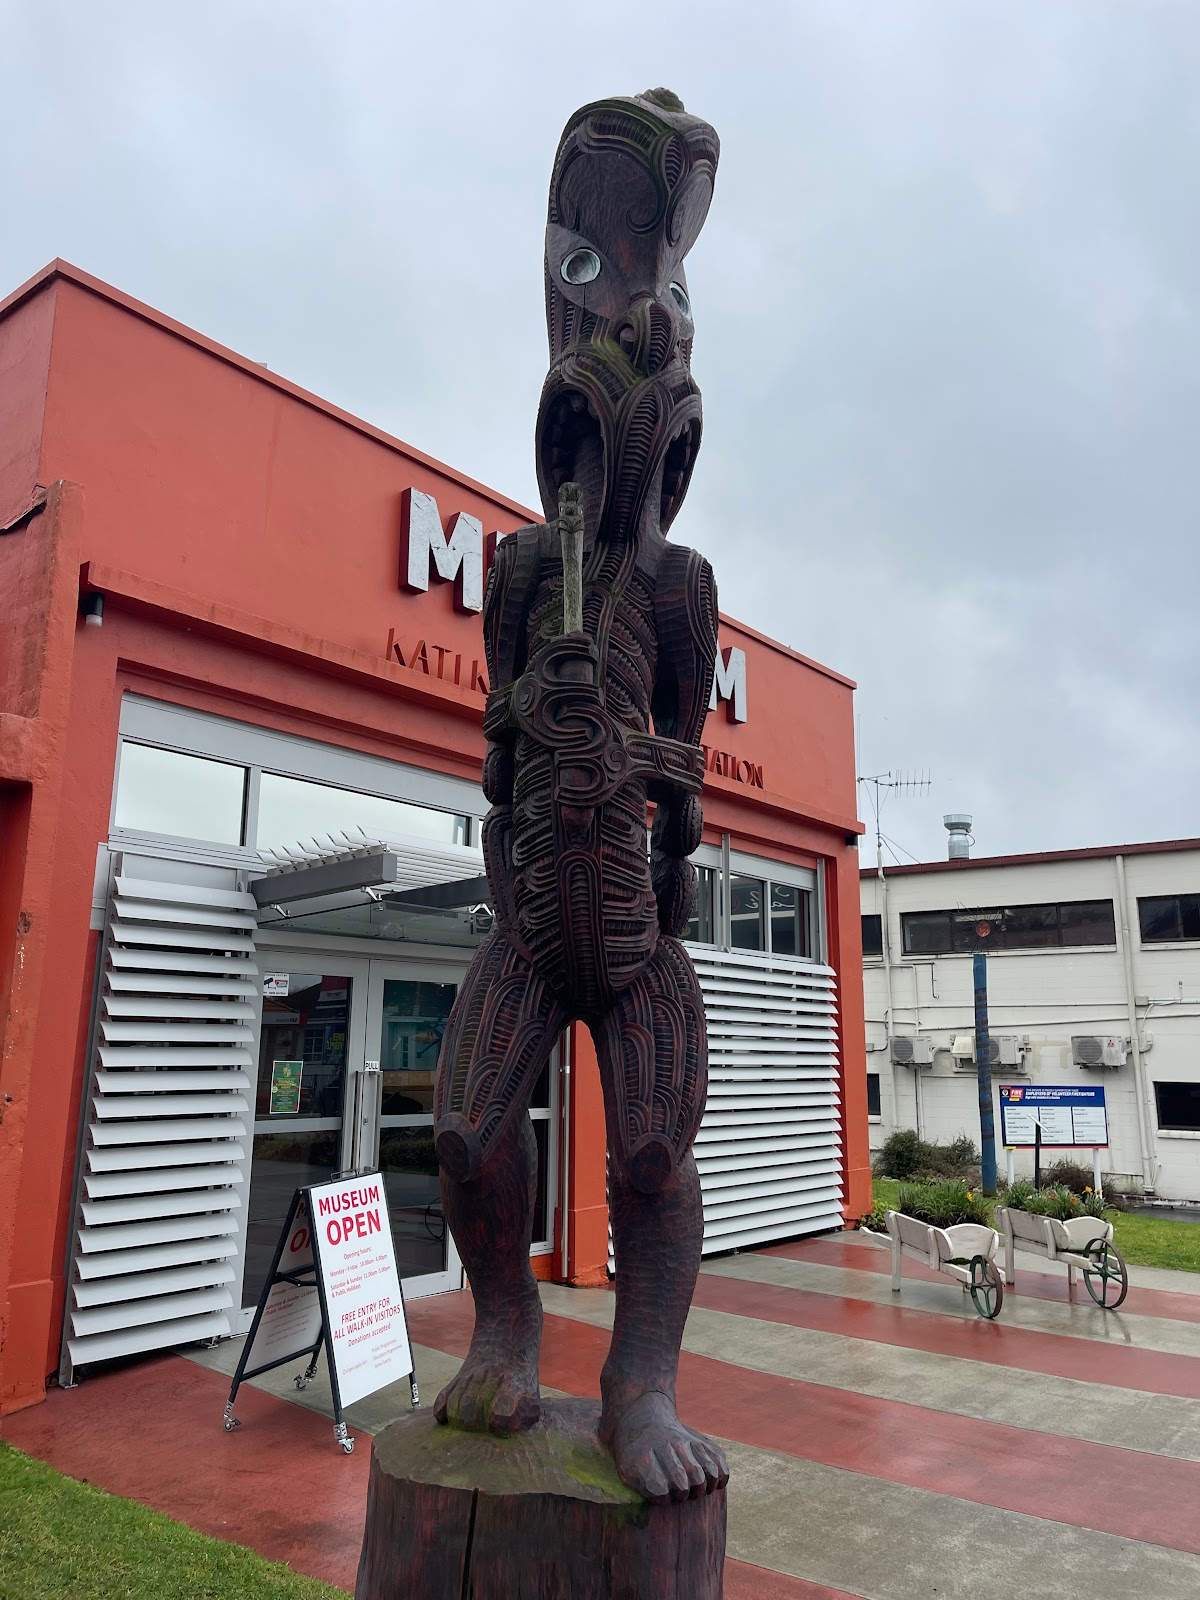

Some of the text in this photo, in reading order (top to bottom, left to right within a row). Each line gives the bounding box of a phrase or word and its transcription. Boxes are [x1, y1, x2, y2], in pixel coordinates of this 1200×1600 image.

[700, 744, 764, 790] TATION
[318, 1185, 380, 1217] MUSEUM
[326, 1208, 382, 1246] OPEN
[333, 1327, 346, 1341] ALL
[346, 1316, 374, 1335] WALK-IN
[374, 1304, 401, 1322] VISITORS
[341, 1297, 391, 1325] FREE ENTRY FOR
[347, 1332, 371, 1348] Donations
[371, 1322, 392, 1337] accepted
